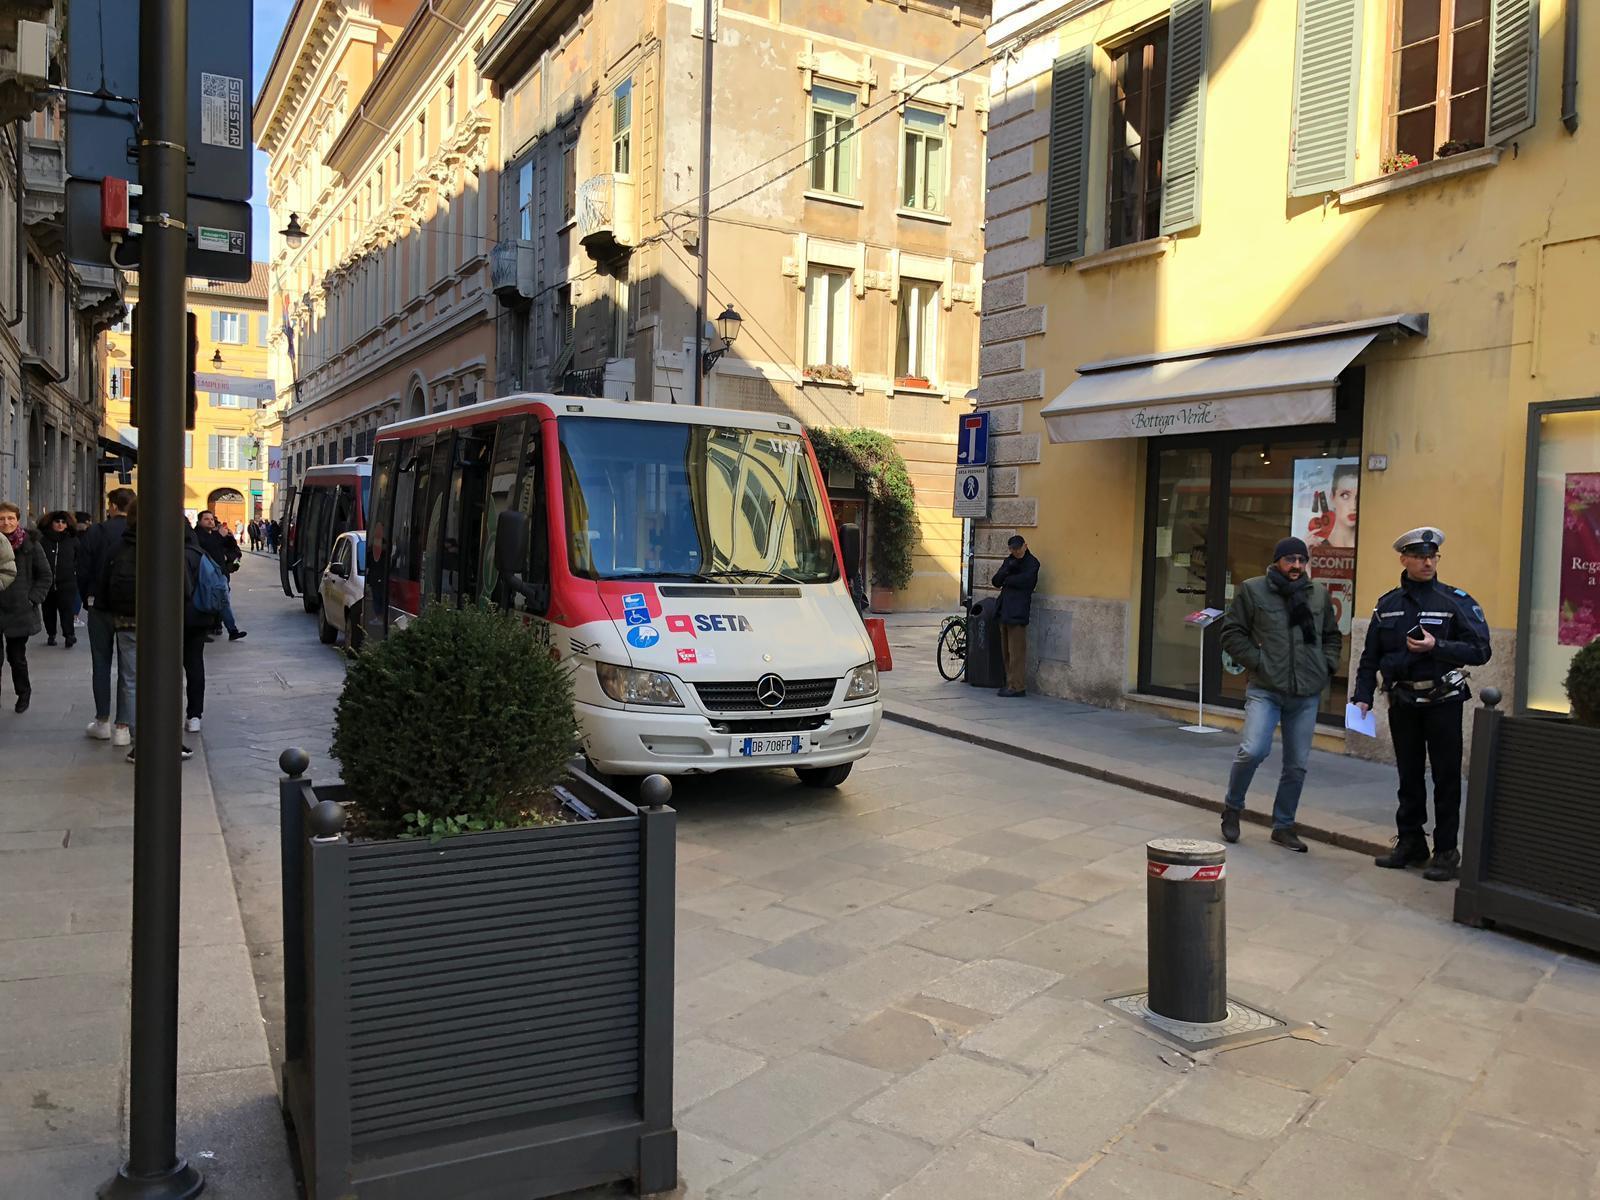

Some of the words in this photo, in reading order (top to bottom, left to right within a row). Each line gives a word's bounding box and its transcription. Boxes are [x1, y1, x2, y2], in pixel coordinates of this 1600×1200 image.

[229, 80, 240, 145] SIBESTAR
[1132, 407, 1175, 434] Bottega
[1177, 401, 1214, 425] Verde
[1311, 556, 1355, 569] SCONTI
[694, 614, 753, 632] SETA
[752, 741, 763, 752] DB
[766, 739, 792, 752] 708FP
